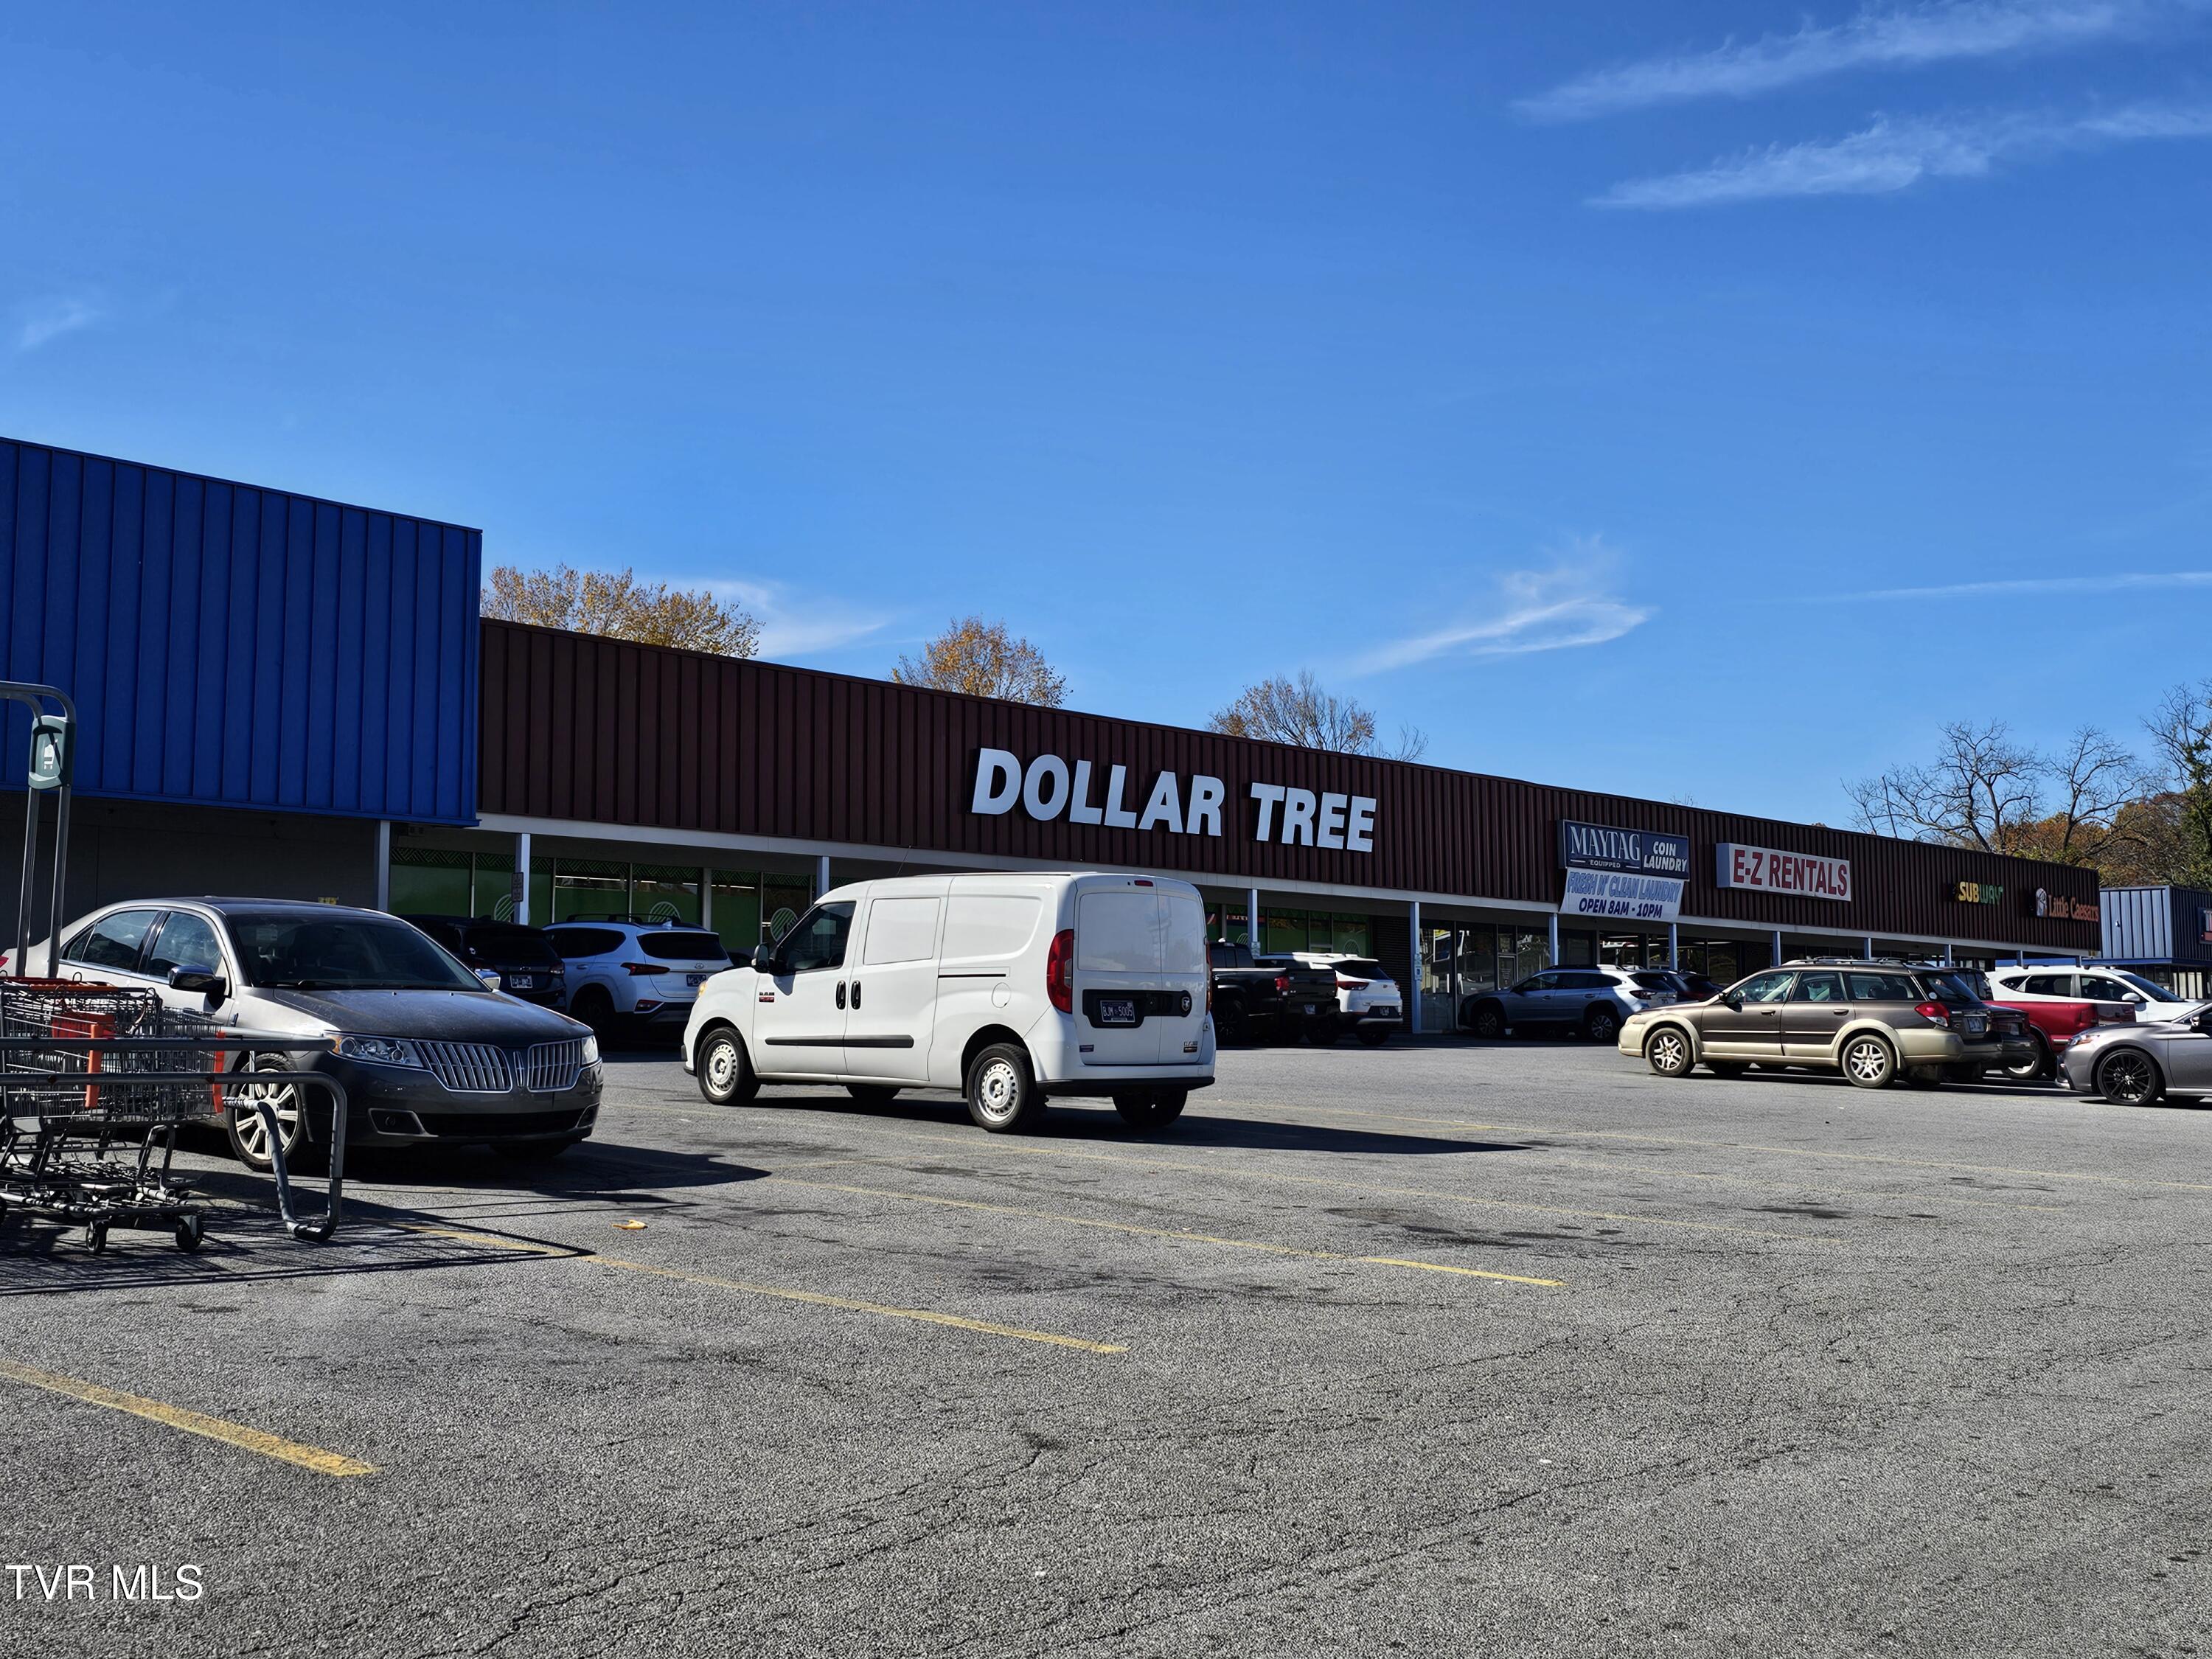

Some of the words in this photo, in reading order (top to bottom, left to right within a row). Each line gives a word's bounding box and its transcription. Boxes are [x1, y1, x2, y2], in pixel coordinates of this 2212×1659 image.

[972, 748, 1225, 837] DOLLAR
[1251, 782, 1377, 852] TREE
[1570, 826, 1641, 861] MAYTAG
[1653, 841, 1676, 857] COIN
[1590, 859, 1621, 868] EQUIPPED
[1644, 855, 1687, 872] LAUNDRY
[1733, 849, 1764, 886] E-Z
[1769, 854, 1848, 897] RENTALS
[1567, 872, 1598, 895] FRESH
[1609, 875, 1639, 899] CLEAN
[1638, 879, 1681, 902] LAUNDRY
[1958, 881, 2003, 905] SUBWAY
[1579, 898, 1607, 914] OPEN
[1608, 900, 1630, 916] 8AM
[1636, 902, 1663, 918] 10PM
[2048, 894, 2068, 918] Little
[2070, 896, 2098, 922] Caesars
